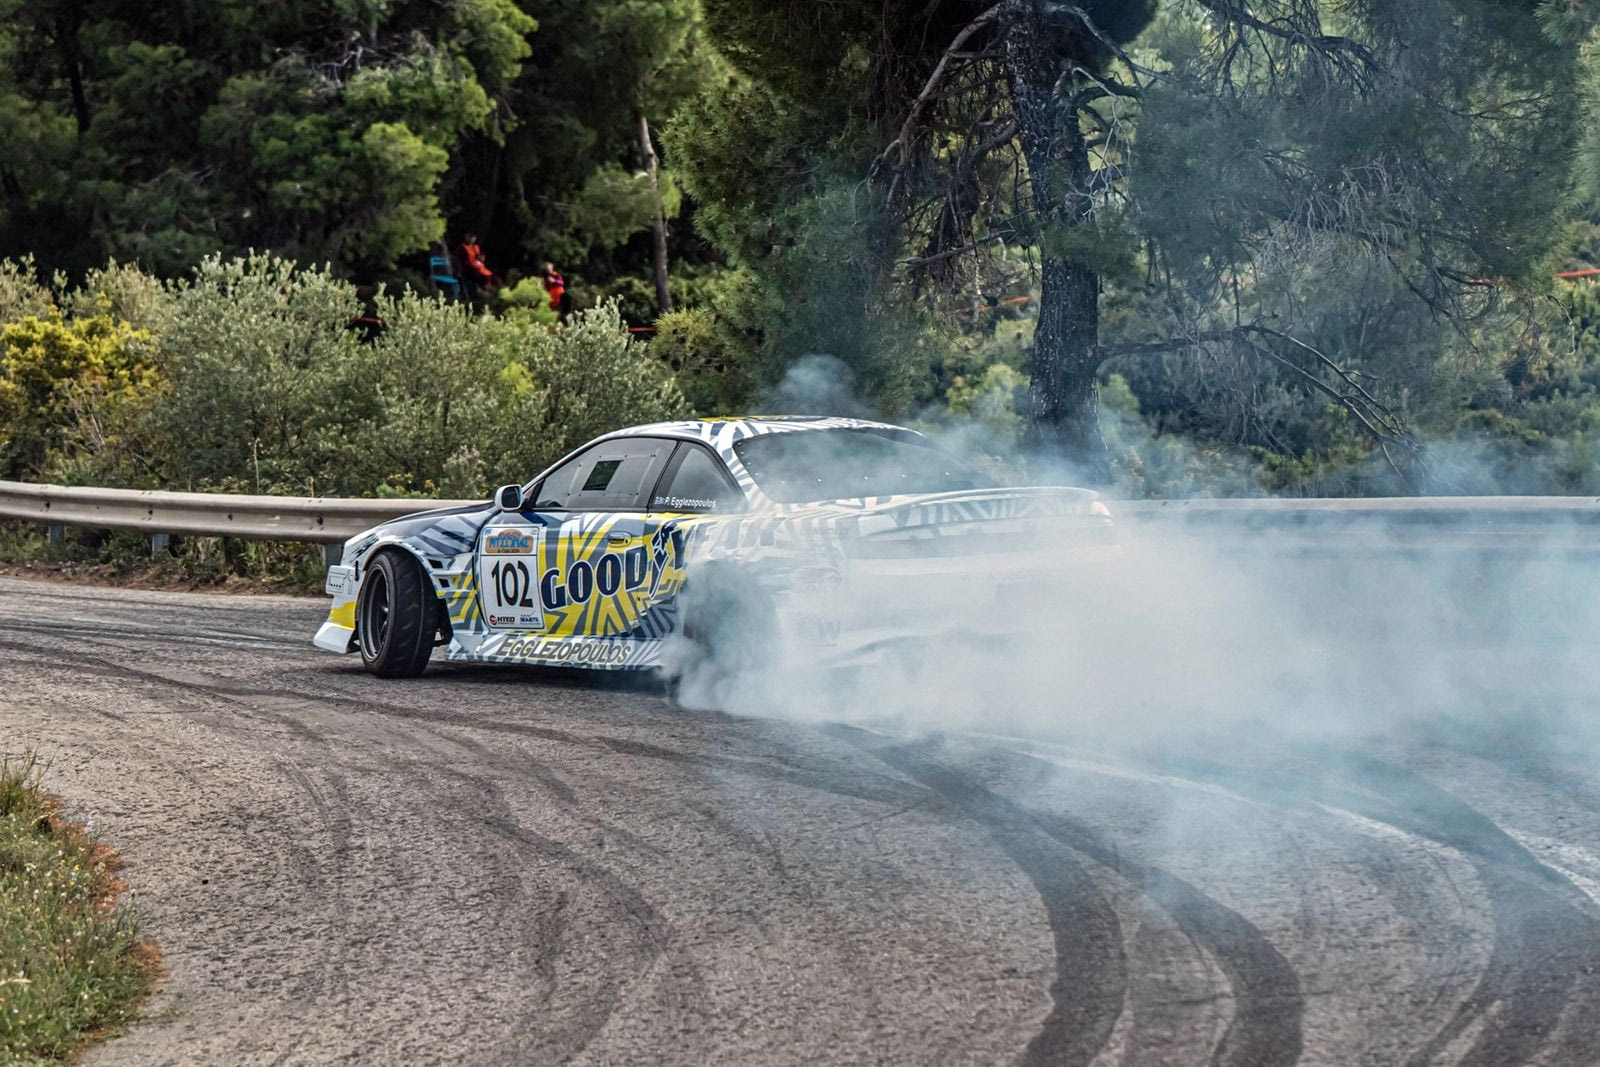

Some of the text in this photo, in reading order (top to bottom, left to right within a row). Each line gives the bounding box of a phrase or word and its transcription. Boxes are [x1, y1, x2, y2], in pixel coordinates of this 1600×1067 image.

[671, 496, 717, 509] Egglezopoulos
[491, 560, 534, 608] 102
[496, 634, 632, 664] EGGLEZOPOULOS
